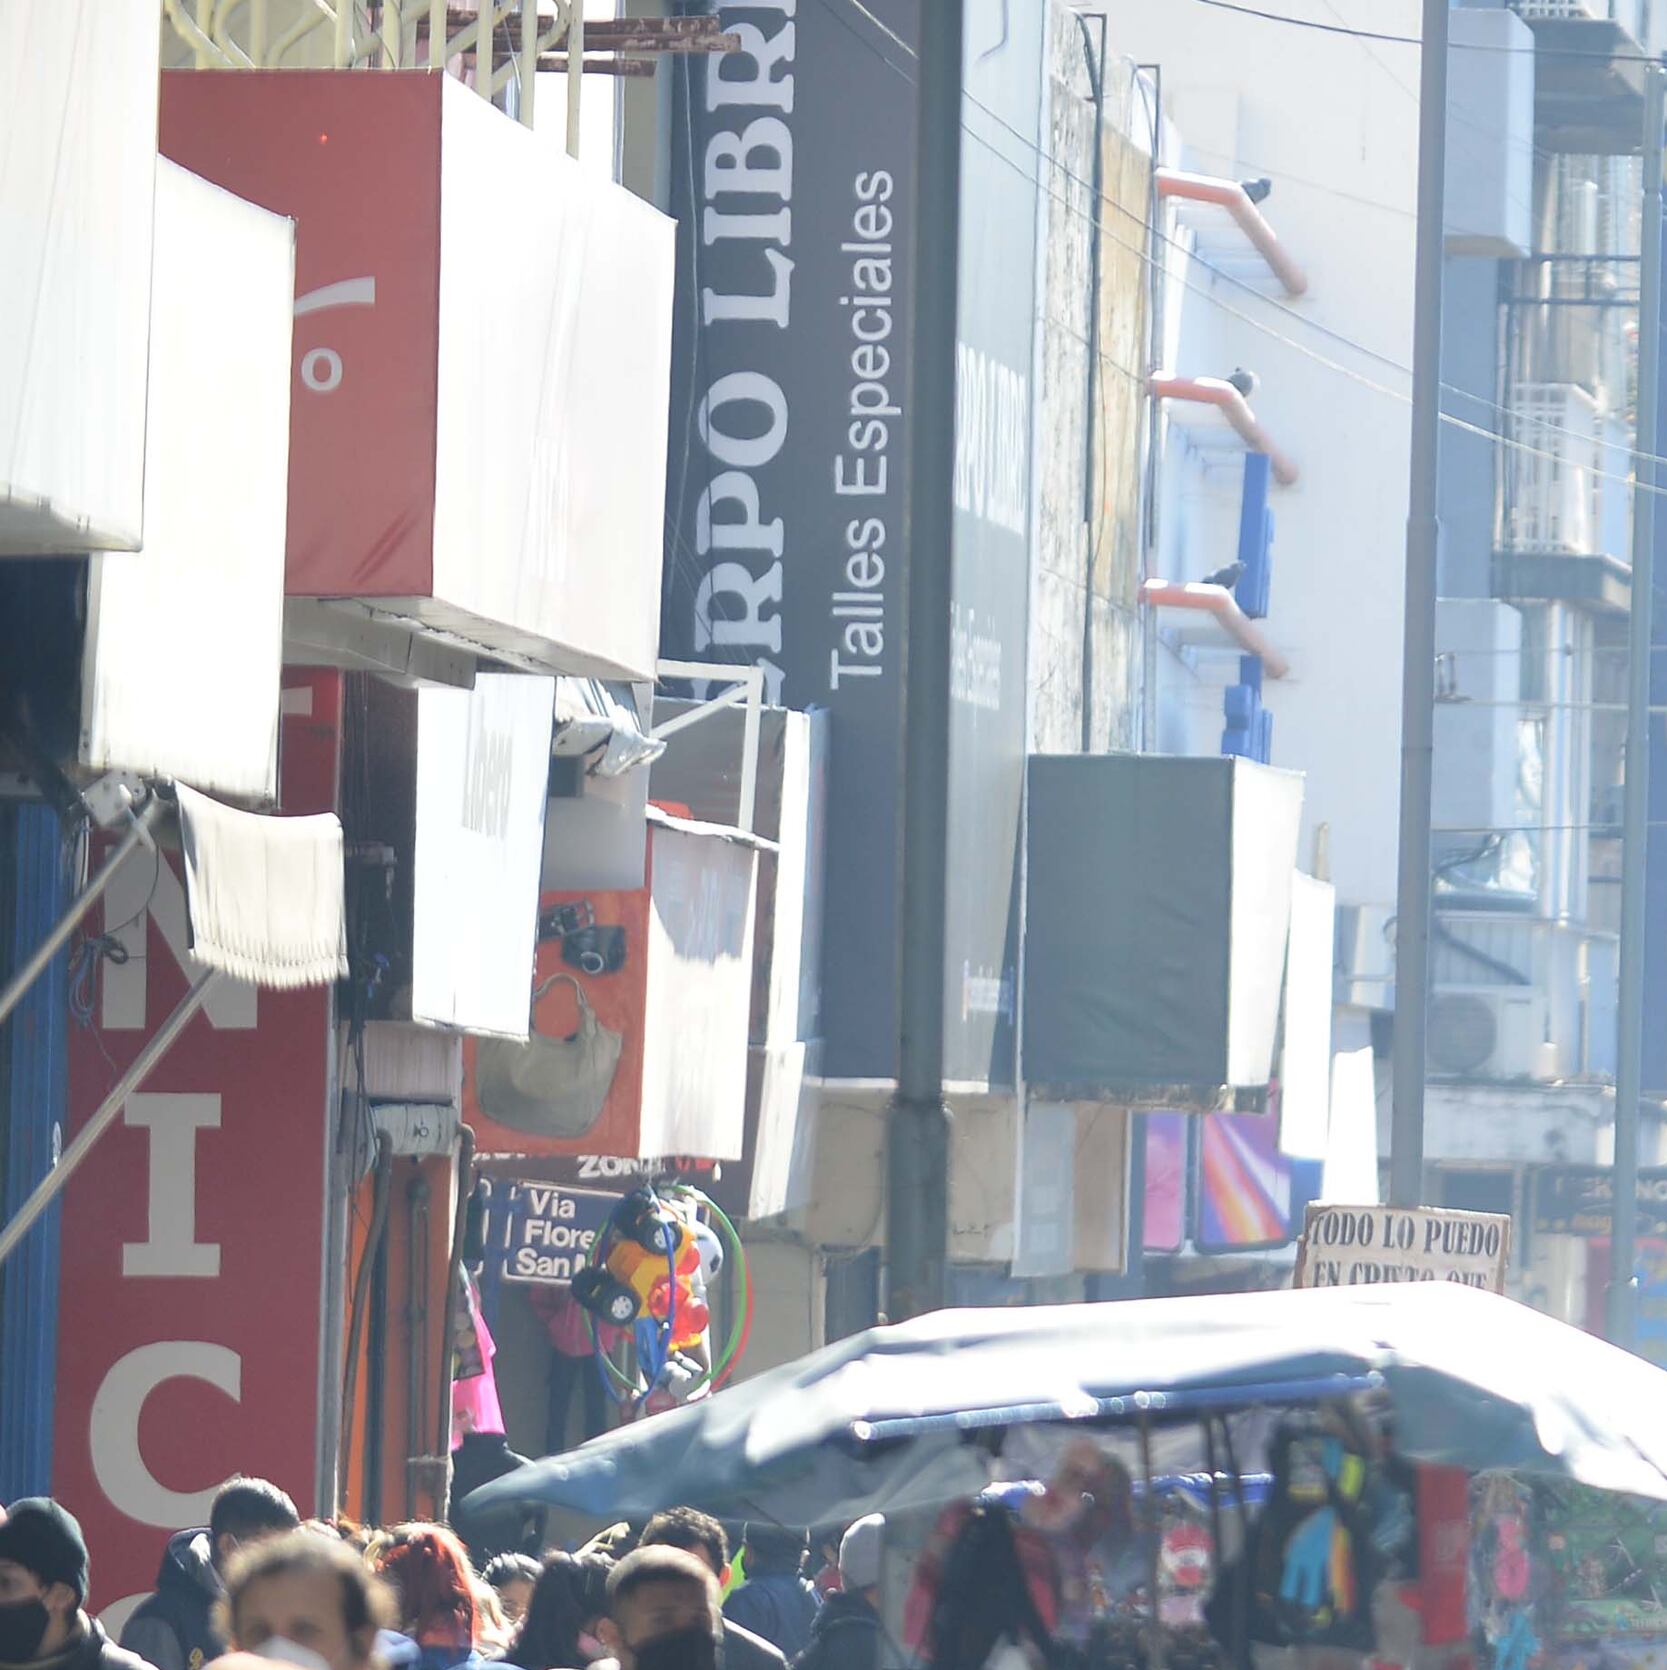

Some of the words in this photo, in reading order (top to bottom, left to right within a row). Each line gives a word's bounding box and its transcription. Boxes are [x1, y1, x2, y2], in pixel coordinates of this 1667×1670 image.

[702, 0, 799, 329] LIBR
[835, 168, 902, 498] Especiales
[831, 518, 886, 689] Talles
[524, 1219, 597, 1248] Flore
[531, 1188, 576, 1219] Via
[1311, 1212, 1374, 1247] TODO
[1383, 1214, 1415, 1250] LO
[1424, 1219, 1500, 1257] PUEDO
